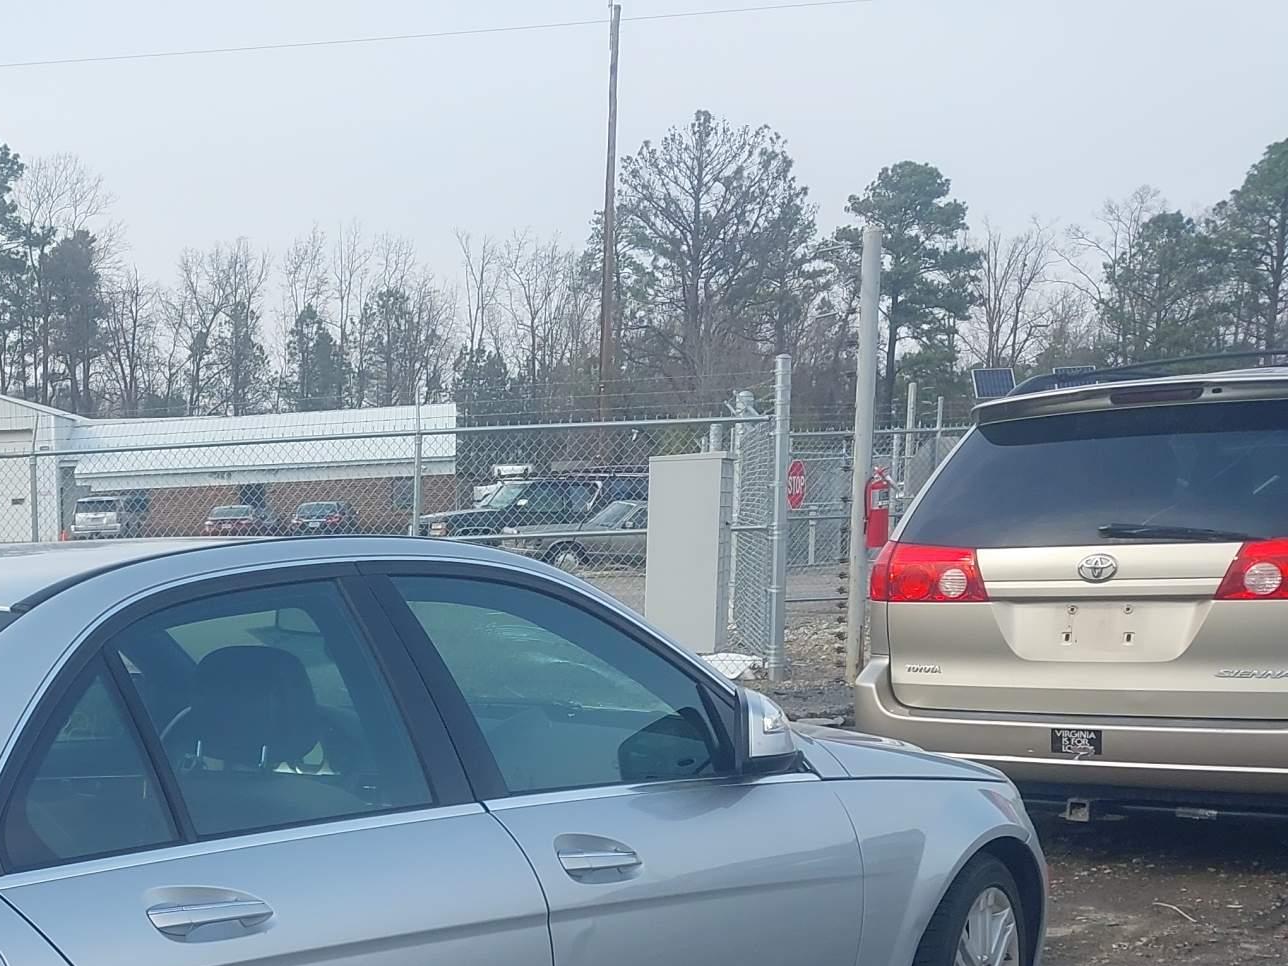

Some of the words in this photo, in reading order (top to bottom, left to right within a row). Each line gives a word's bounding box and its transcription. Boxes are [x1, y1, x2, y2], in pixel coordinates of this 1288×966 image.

[787, 475, 805, 495] STOP
[904, 663, 943, 674] TOYOTA
[1054, 729, 1096, 739] VIRGINIA
[1062, 737, 1070, 745] IS
[1071, 738, 1091, 747] FOR
